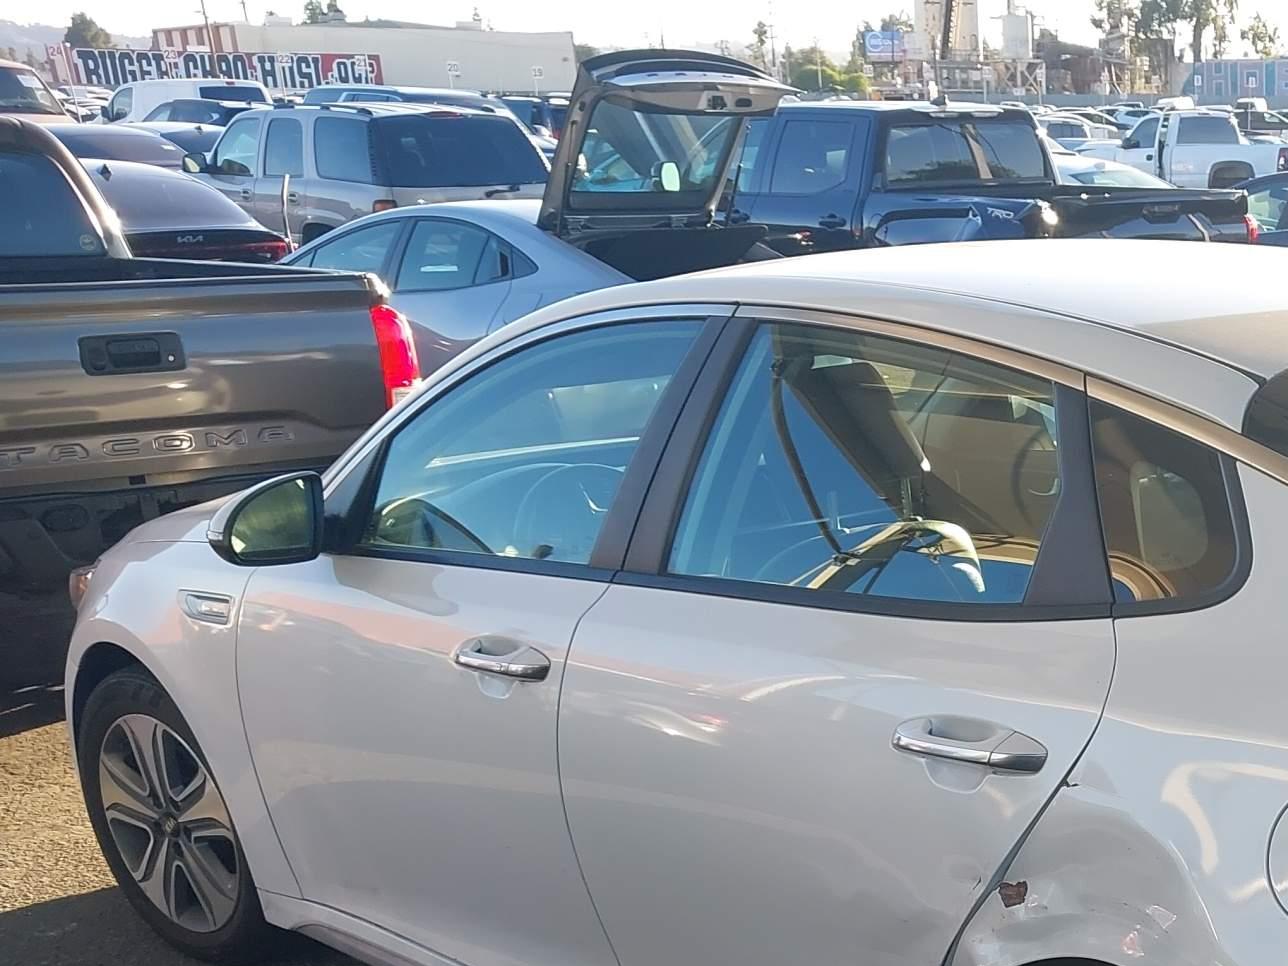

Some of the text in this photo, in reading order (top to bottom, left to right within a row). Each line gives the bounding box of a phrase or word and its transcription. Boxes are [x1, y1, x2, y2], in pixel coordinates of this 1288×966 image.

[165, 49, 177, 60] 23
[278, 55, 291, 64] 22
[447, 62, 459, 73] 20
[986, 206, 1015, 219] TRD
[0, 425, 297, 465] TACOMA
